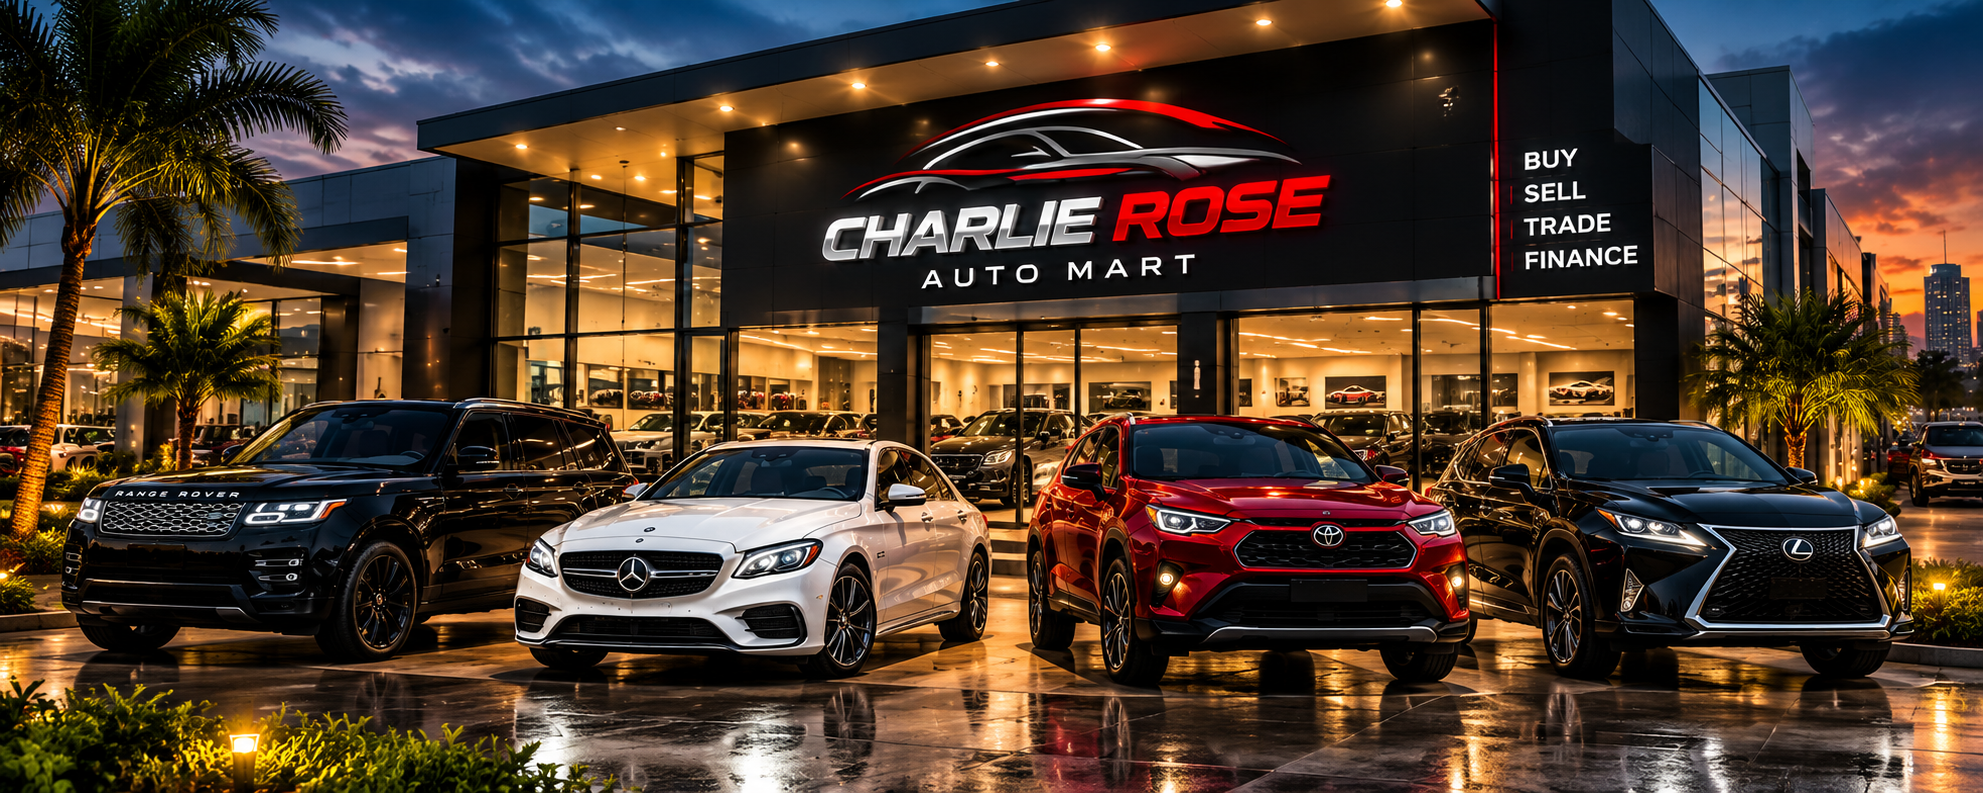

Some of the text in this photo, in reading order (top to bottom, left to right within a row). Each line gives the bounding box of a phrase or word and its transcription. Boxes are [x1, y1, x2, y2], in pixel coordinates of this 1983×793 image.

[1524, 148, 1578, 171] BUY
[1524, 181, 1587, 204] SELL
[821, 175, 1331, 261] CHARLIE ROSE
[1523, 213, 1612, 237] TRADE
[1524, 245, 1639, 270] FINANCE
[921, 254, 1196, 289] AUTO MART
[115, 490, 240, 498] RANGE ROVER
